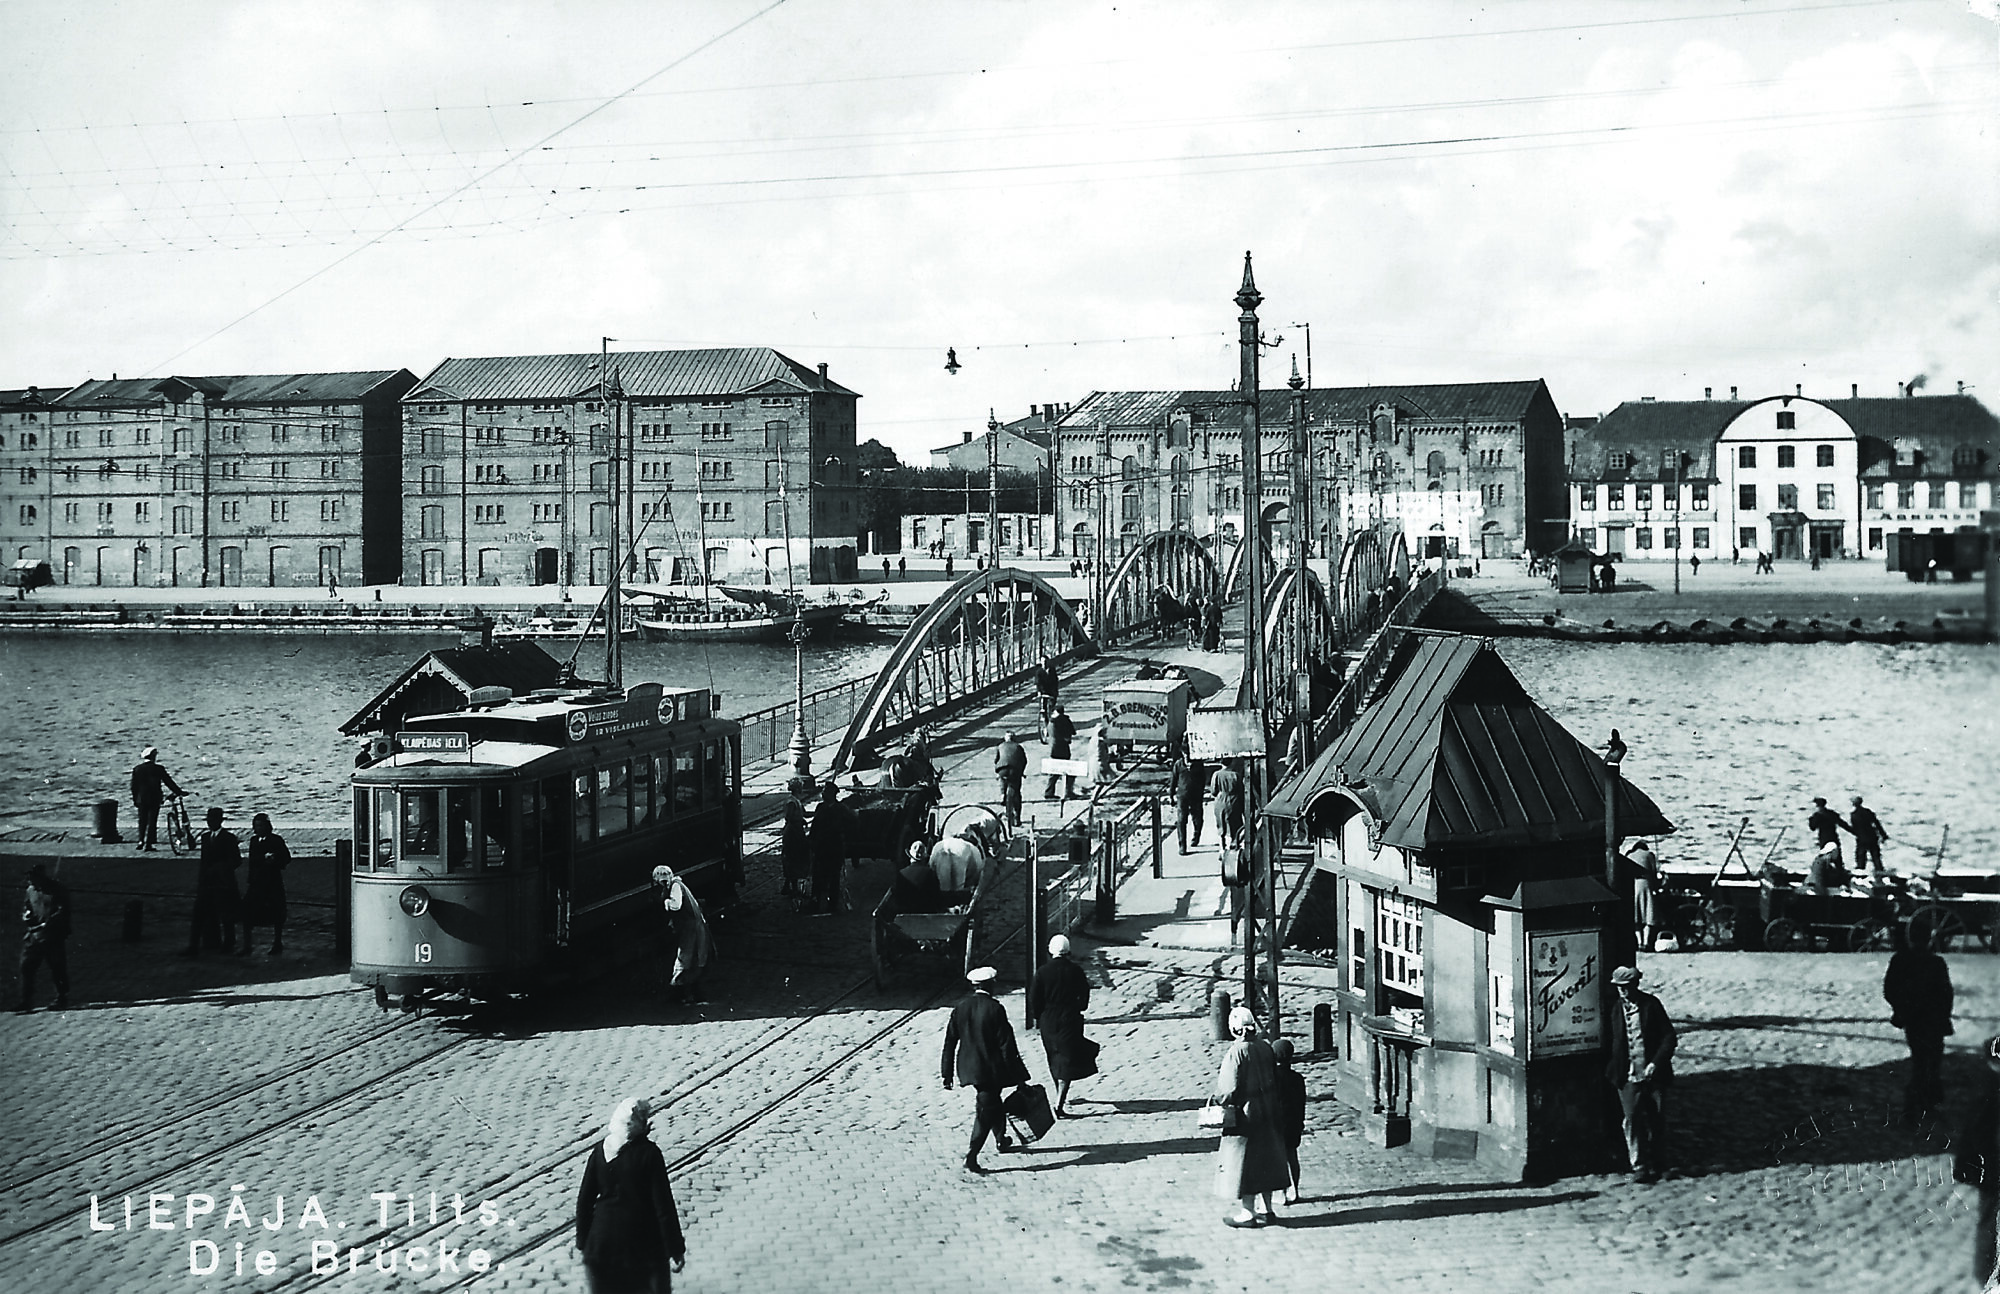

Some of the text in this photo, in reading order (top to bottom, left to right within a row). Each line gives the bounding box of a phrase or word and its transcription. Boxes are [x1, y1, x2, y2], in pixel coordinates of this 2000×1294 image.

[445, 737, 463, 749] IELA
[415, 943, 432, 963] 19
[1537, 954, 1597, 1033] Favorit
